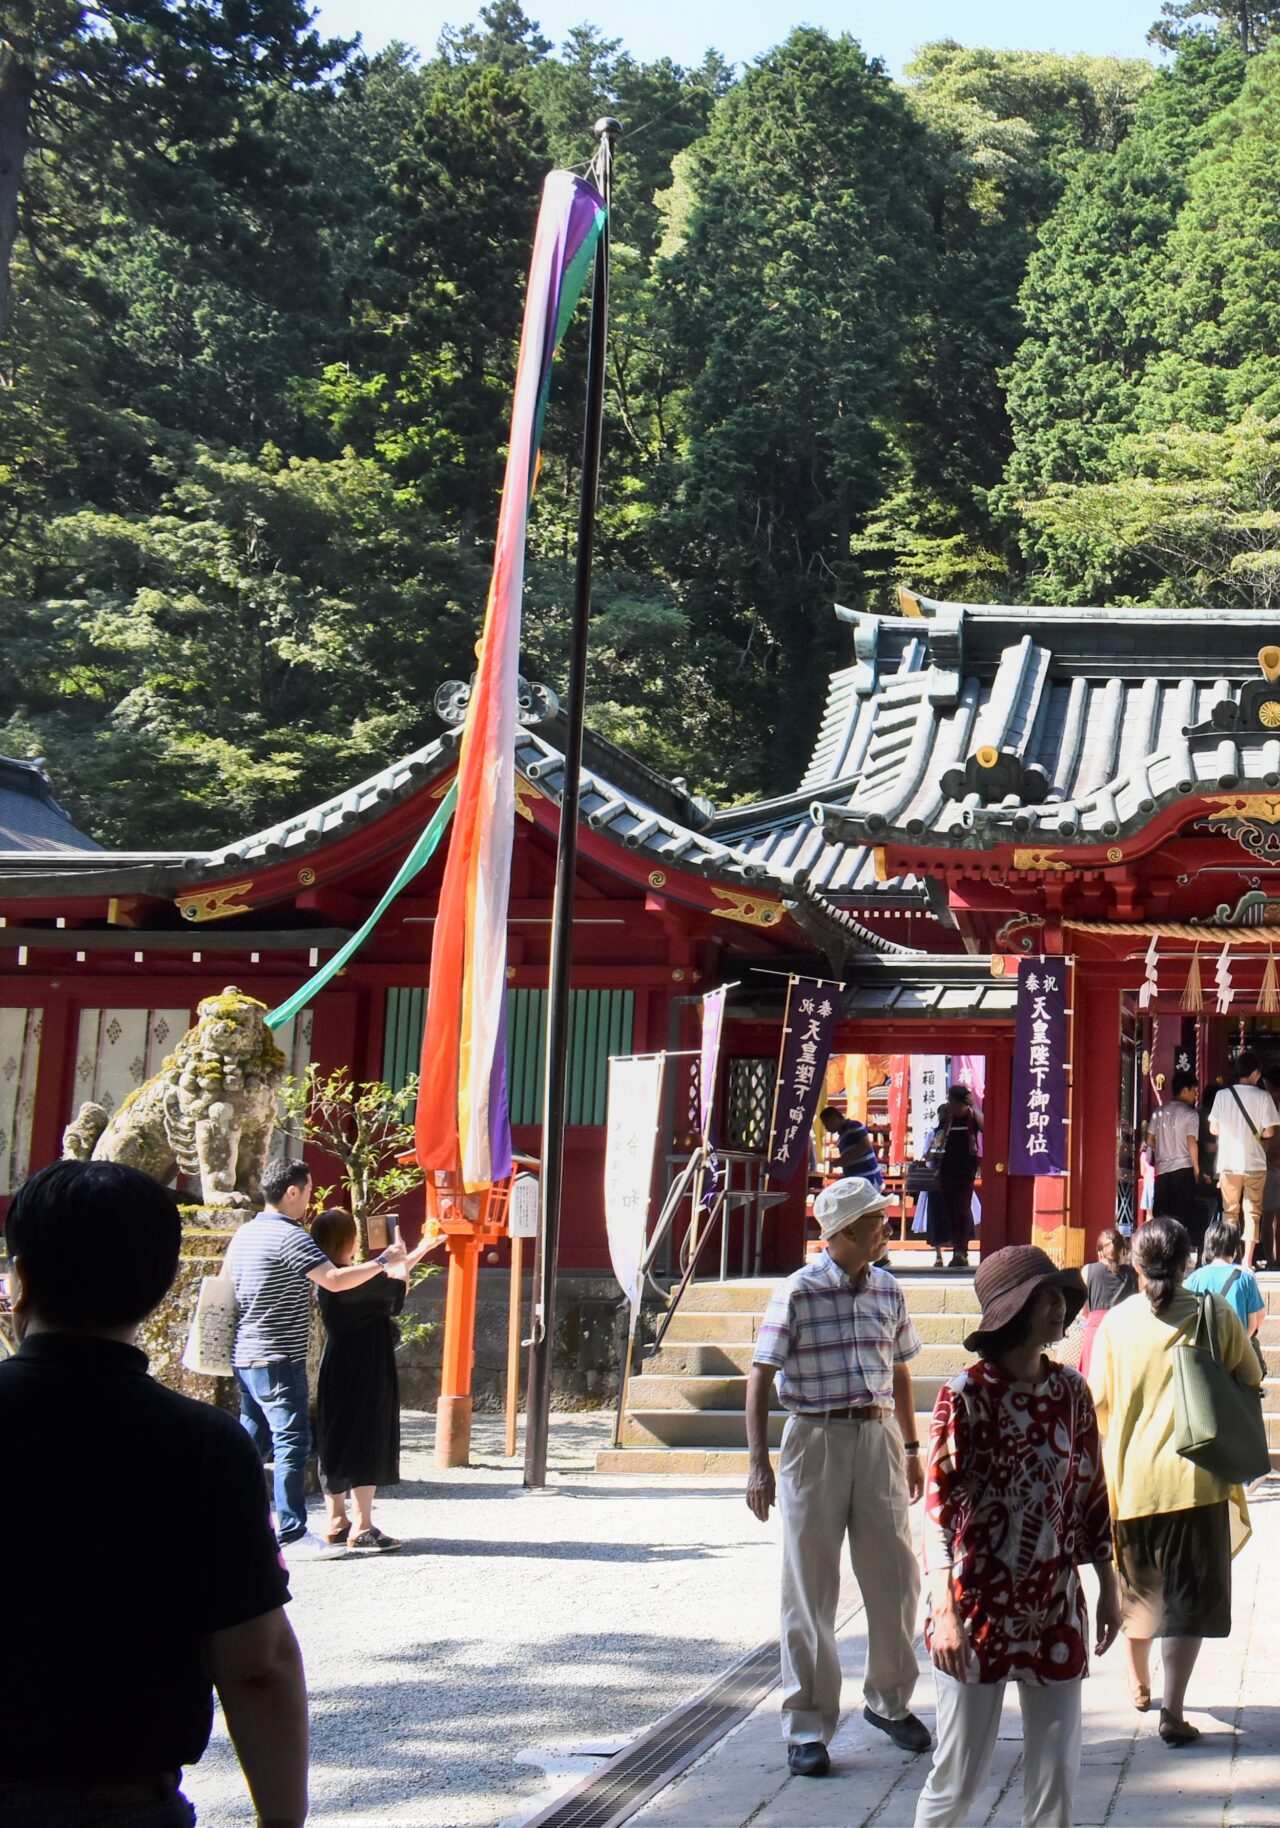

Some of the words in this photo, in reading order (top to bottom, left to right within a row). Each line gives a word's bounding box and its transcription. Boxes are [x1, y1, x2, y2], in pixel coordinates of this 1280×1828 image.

[1025, 972, 1059, 993] 奉祝
[1026, 996, 1051, 1156] 天皇陛下御即位
